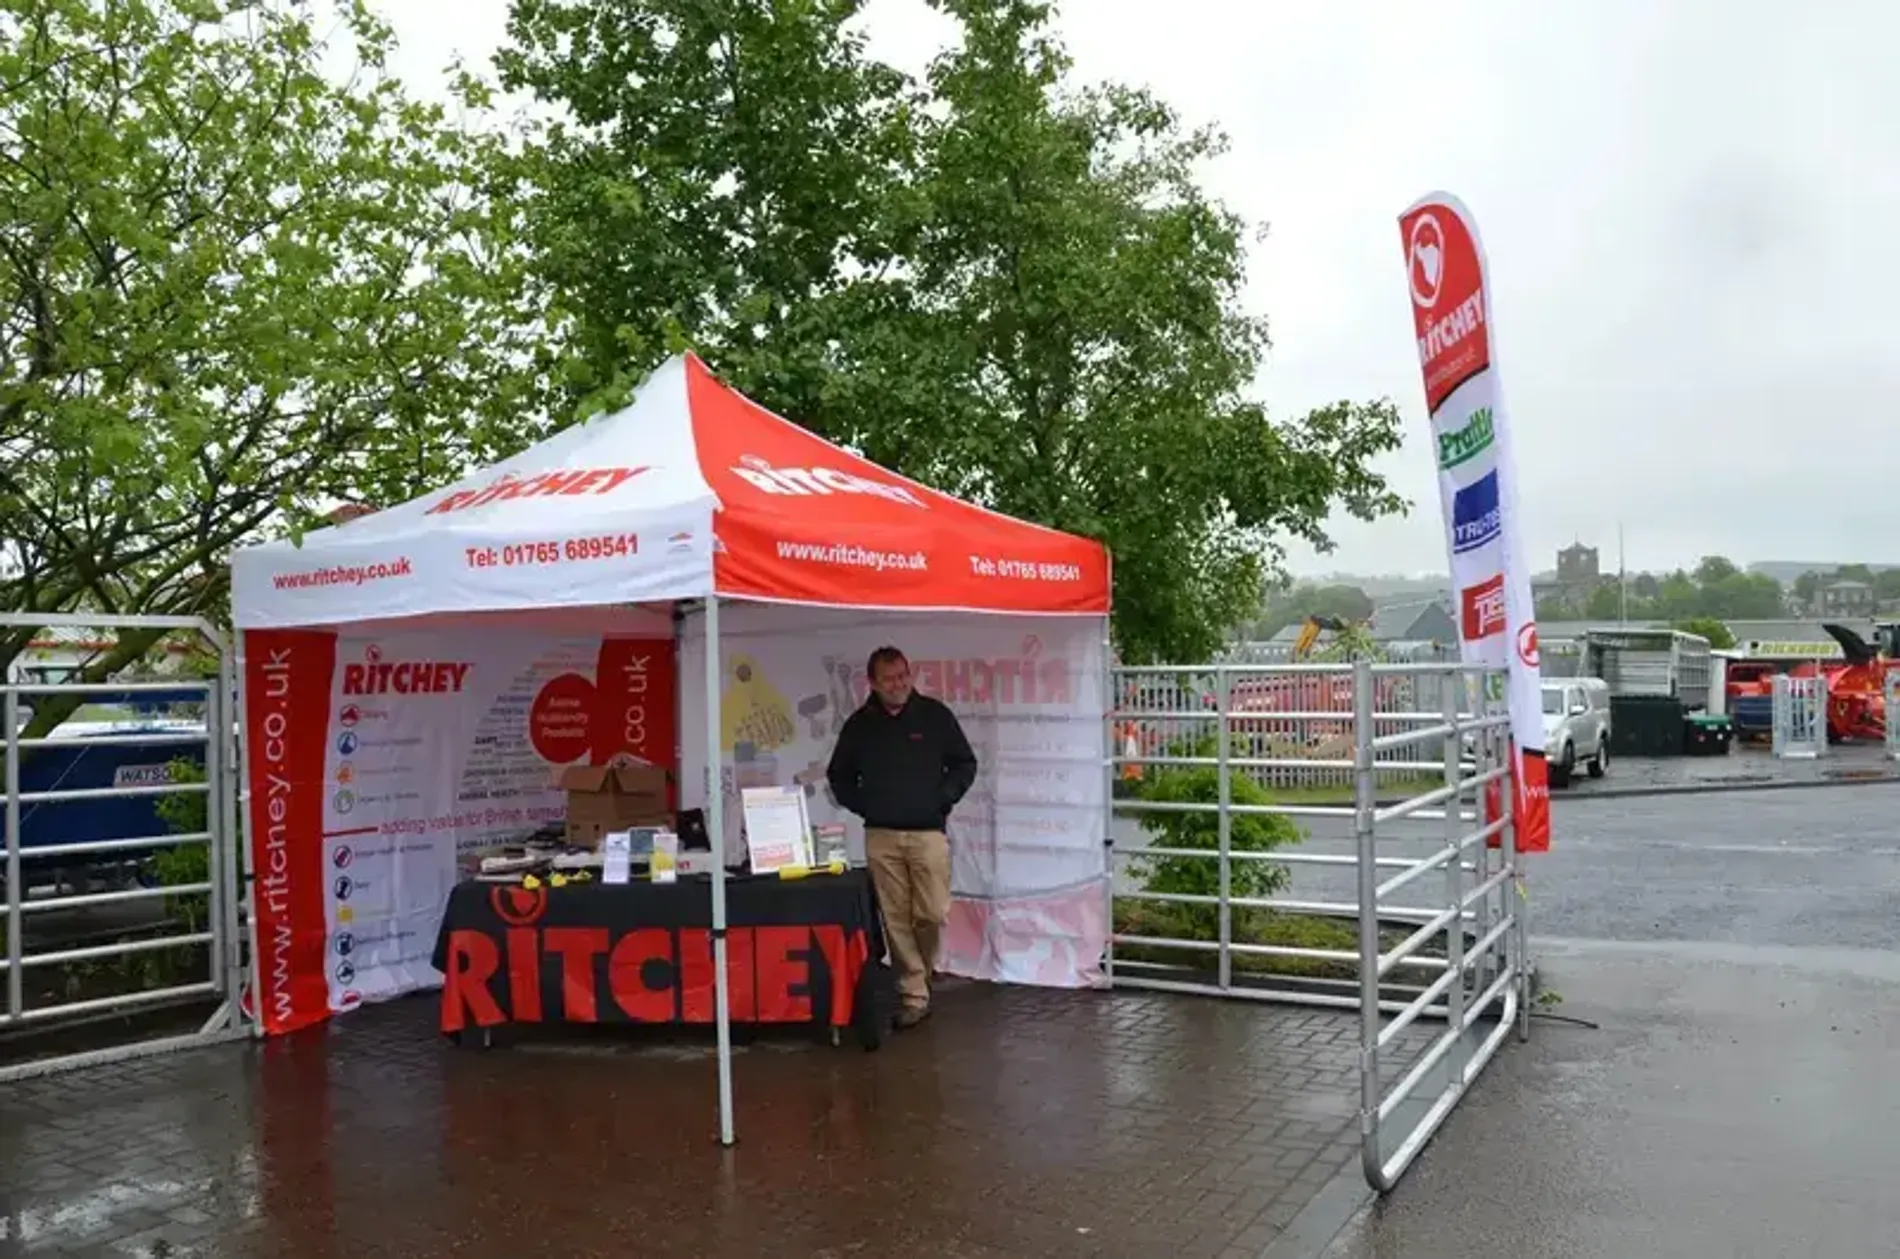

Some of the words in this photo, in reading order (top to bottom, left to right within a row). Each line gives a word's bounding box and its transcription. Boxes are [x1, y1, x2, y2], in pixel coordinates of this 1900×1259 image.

[425, 466, 649, 514] RITCHEY
[467, 546, 497, 568] Tel:
[503, 541, 559, 566] 01765
[565, 534, 638, 560] 689541
[777, 542, 927, 571] www.ritchey.co.uk
[970, 556, 996, 576] Tel:
[998, 559, 1037, 579] 01765
[274, 559, 411, 590] www.ritchey.co.uk
[342, 662, 472, 695] RITCHEY
[622, 655, 650, 753] .co.uk
[120, 766, 173, 783] WATSO
[262, 648, 294, 1021] www.ritchey.co.uk
[440, 926, 869, 1033] RITCHEY
